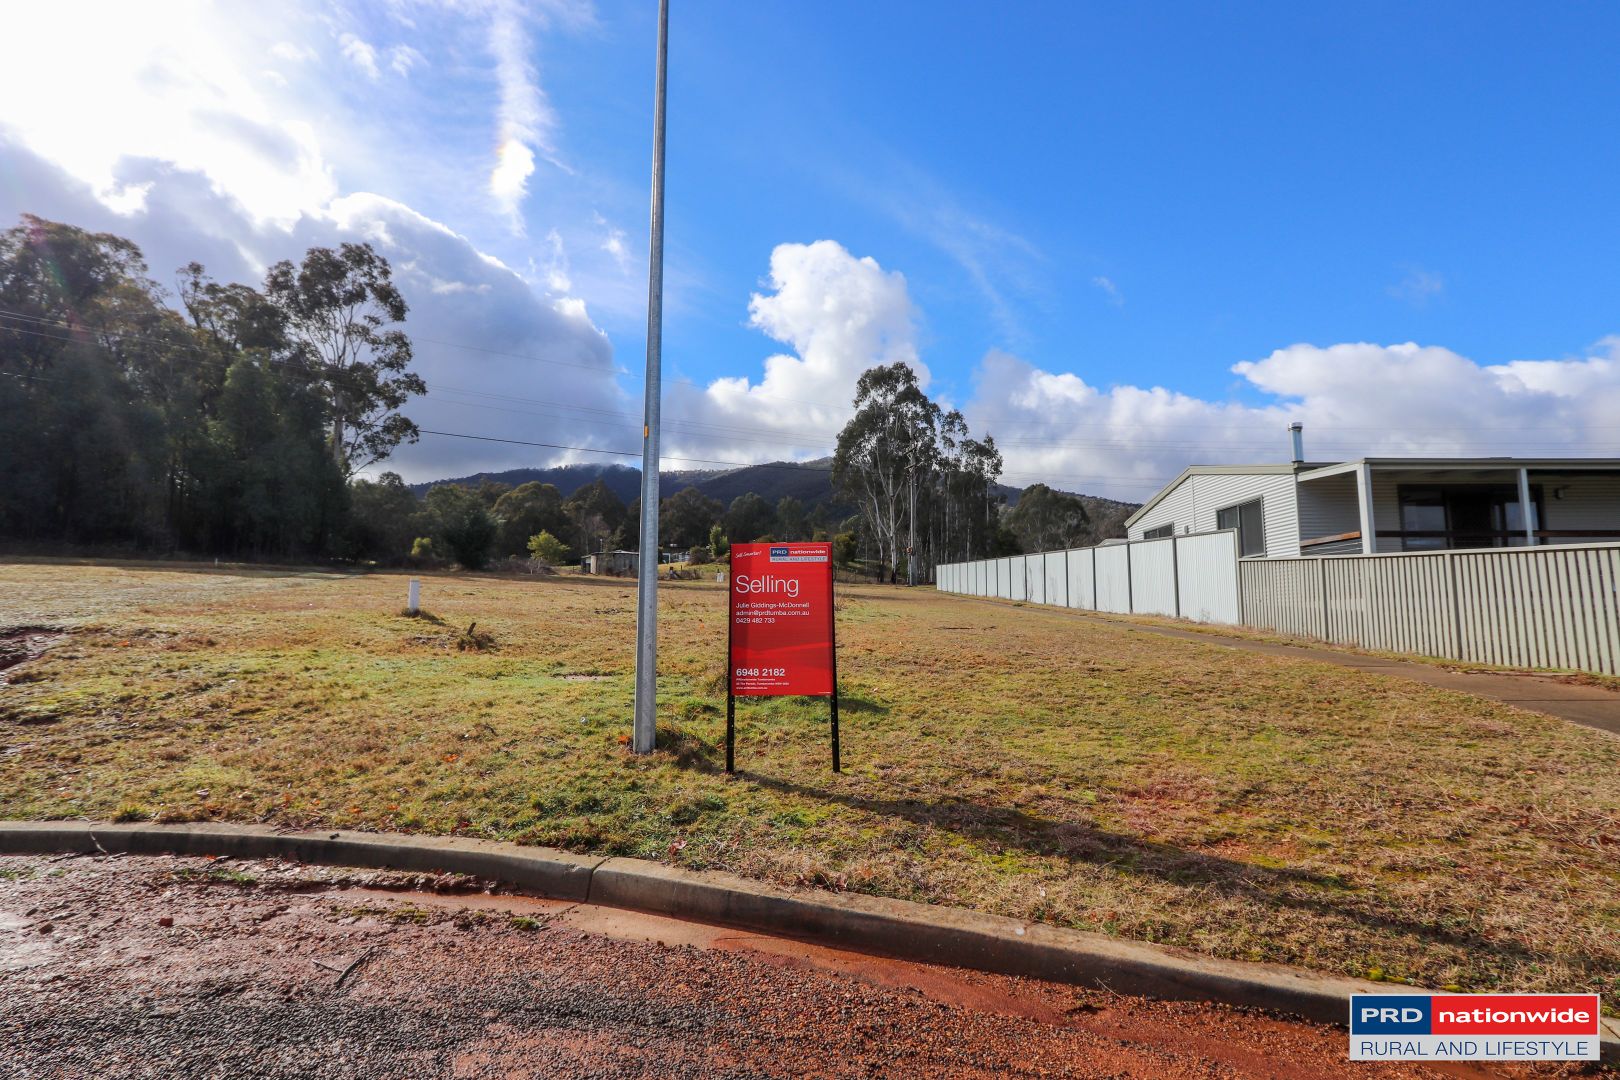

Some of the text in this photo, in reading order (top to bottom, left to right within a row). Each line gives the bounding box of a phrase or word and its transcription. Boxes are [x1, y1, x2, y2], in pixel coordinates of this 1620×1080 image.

[735, 575, 799, 597] Selling
[736, 668, 785, 676] 6948 2182
